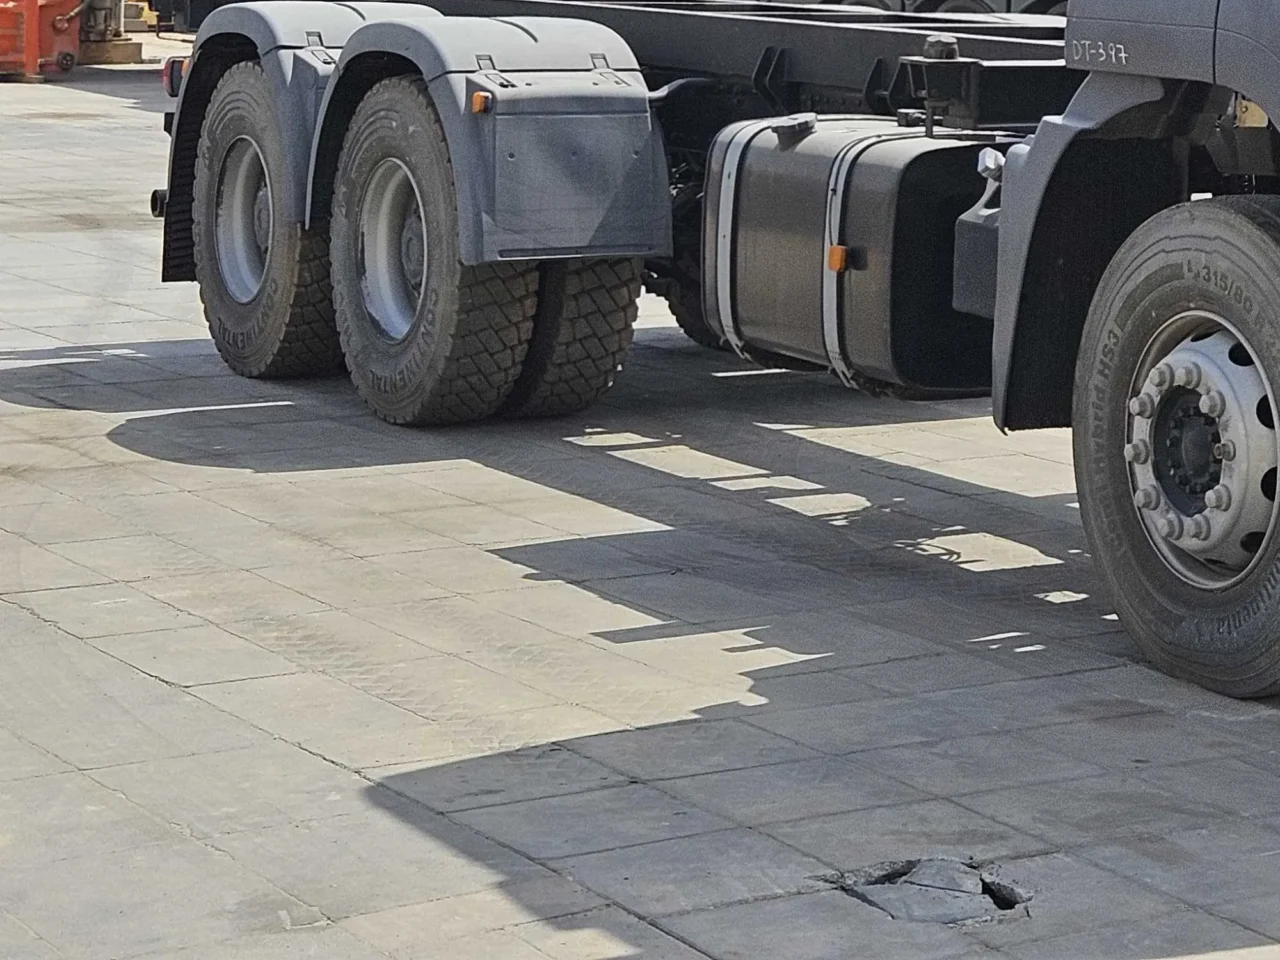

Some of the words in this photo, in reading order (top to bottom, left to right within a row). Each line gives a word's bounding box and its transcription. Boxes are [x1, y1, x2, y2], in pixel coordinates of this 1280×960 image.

[1072, 40, 1129, 65] DT-397
[1202, 264, 1256, 315] 315/80
[1097, 327, 1120, 380] HS3
